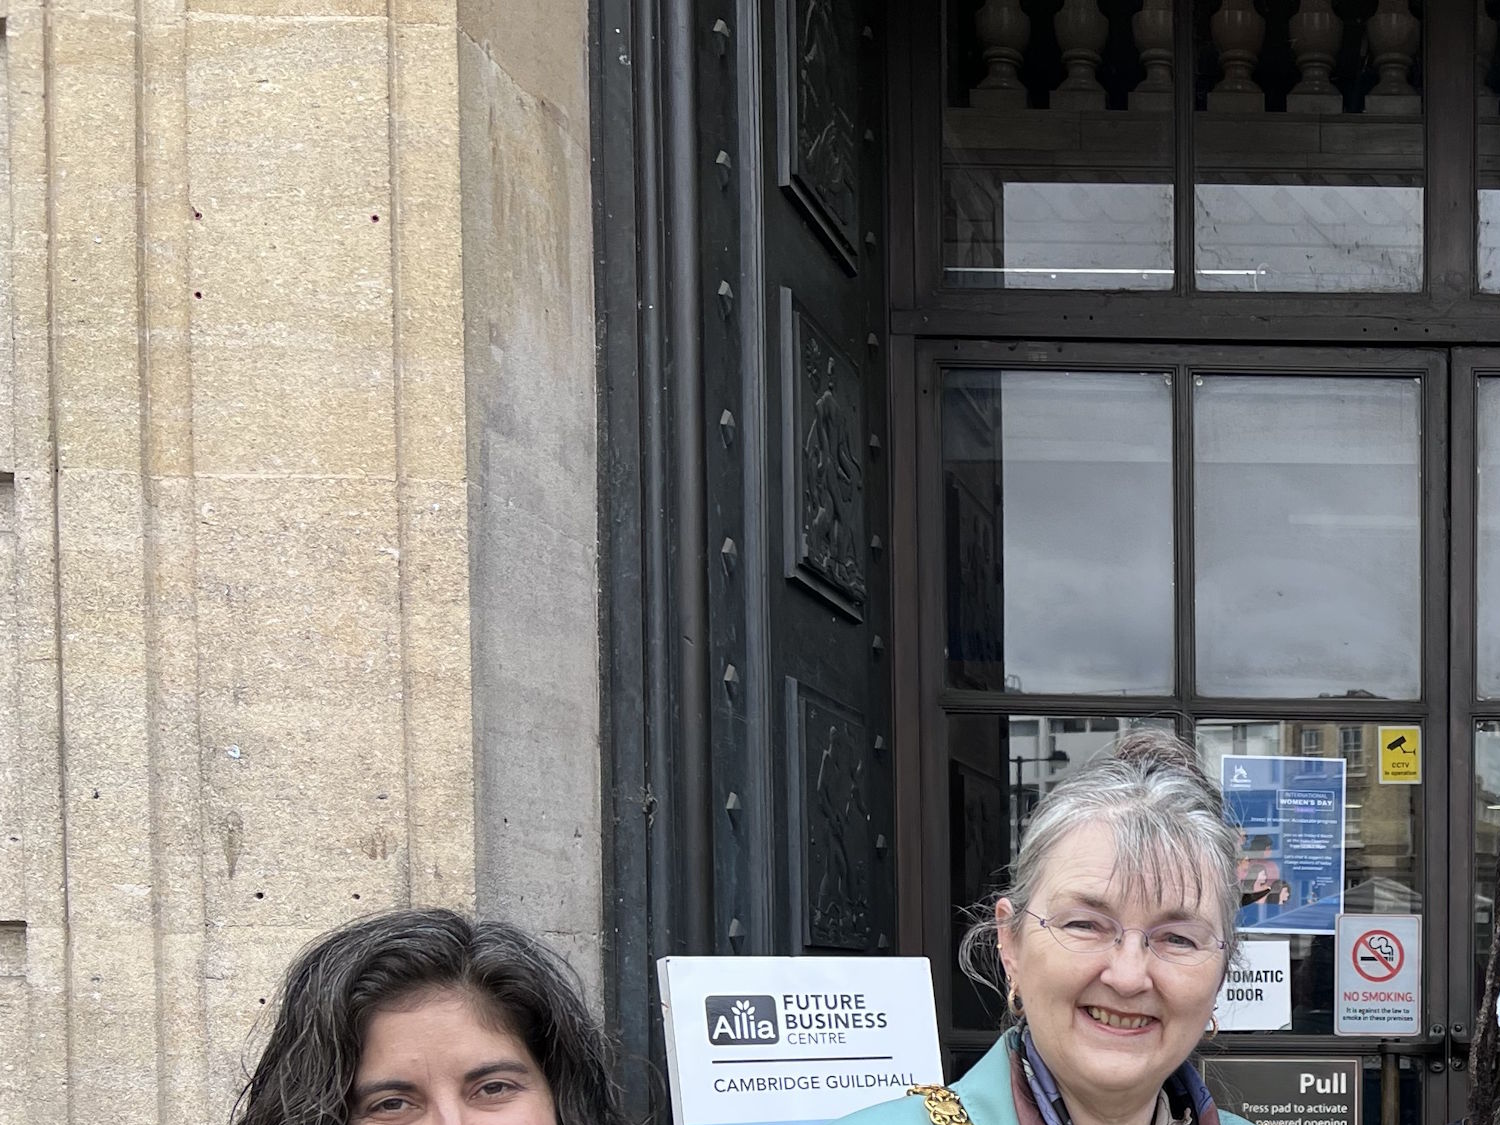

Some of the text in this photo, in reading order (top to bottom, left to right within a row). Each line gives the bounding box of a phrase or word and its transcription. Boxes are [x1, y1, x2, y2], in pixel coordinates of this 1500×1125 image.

[783, 994, 866, 1010] FUTURE
[1226, 988, 1264, 1001] DOOR
[1343, 992, 1360, 1002] NO
[712, 1012, 776, 1040] Allia
[785, 1012, 888, 1029] BUSINESS
[787, 1032, 846, 1045] CENTRE
[714, 1072, 917, 1093] CAMBRIDGE GUILDHALL
[1300, 1073, 1346, 1094] Pull
[1242, 1102, 1348, 1115] Press pad to activate
